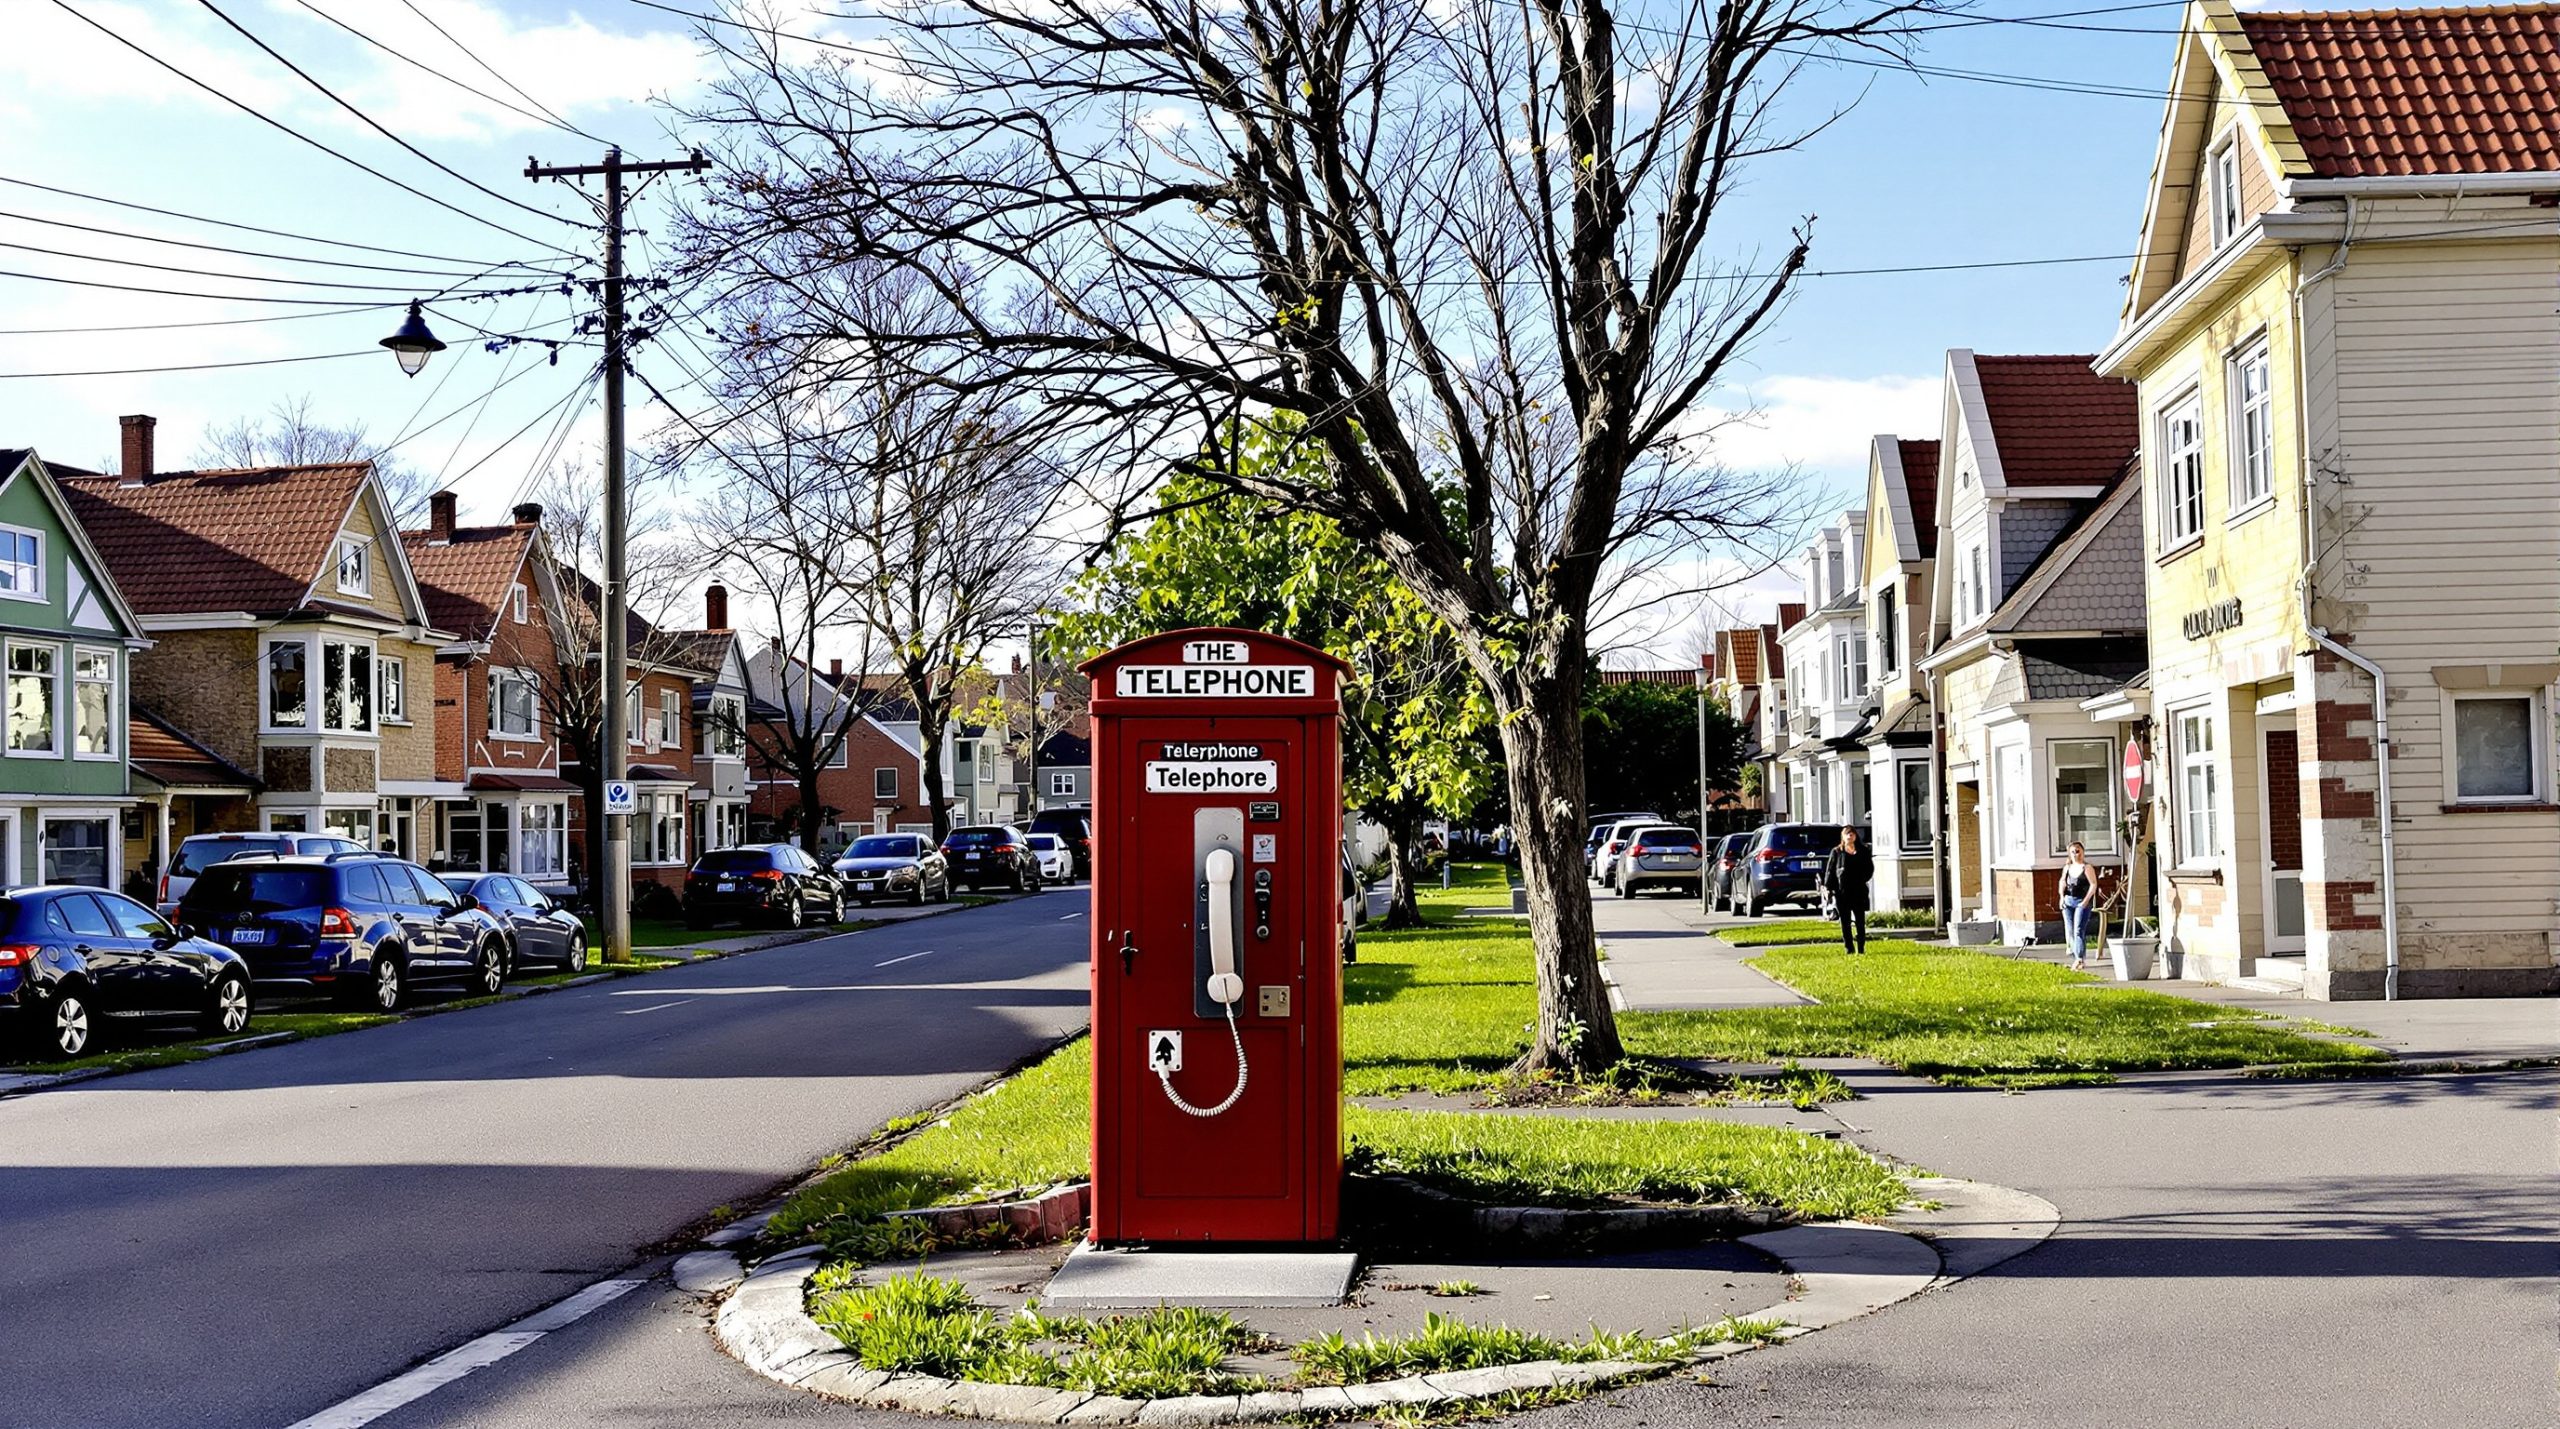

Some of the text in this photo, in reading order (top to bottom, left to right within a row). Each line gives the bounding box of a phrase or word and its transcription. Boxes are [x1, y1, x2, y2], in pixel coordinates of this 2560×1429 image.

[1193, 643, 1236, 661] THE
[1126, 669, 1306, 694] TELEPHONE
[1156, 767, 1266, 791] Telephore
